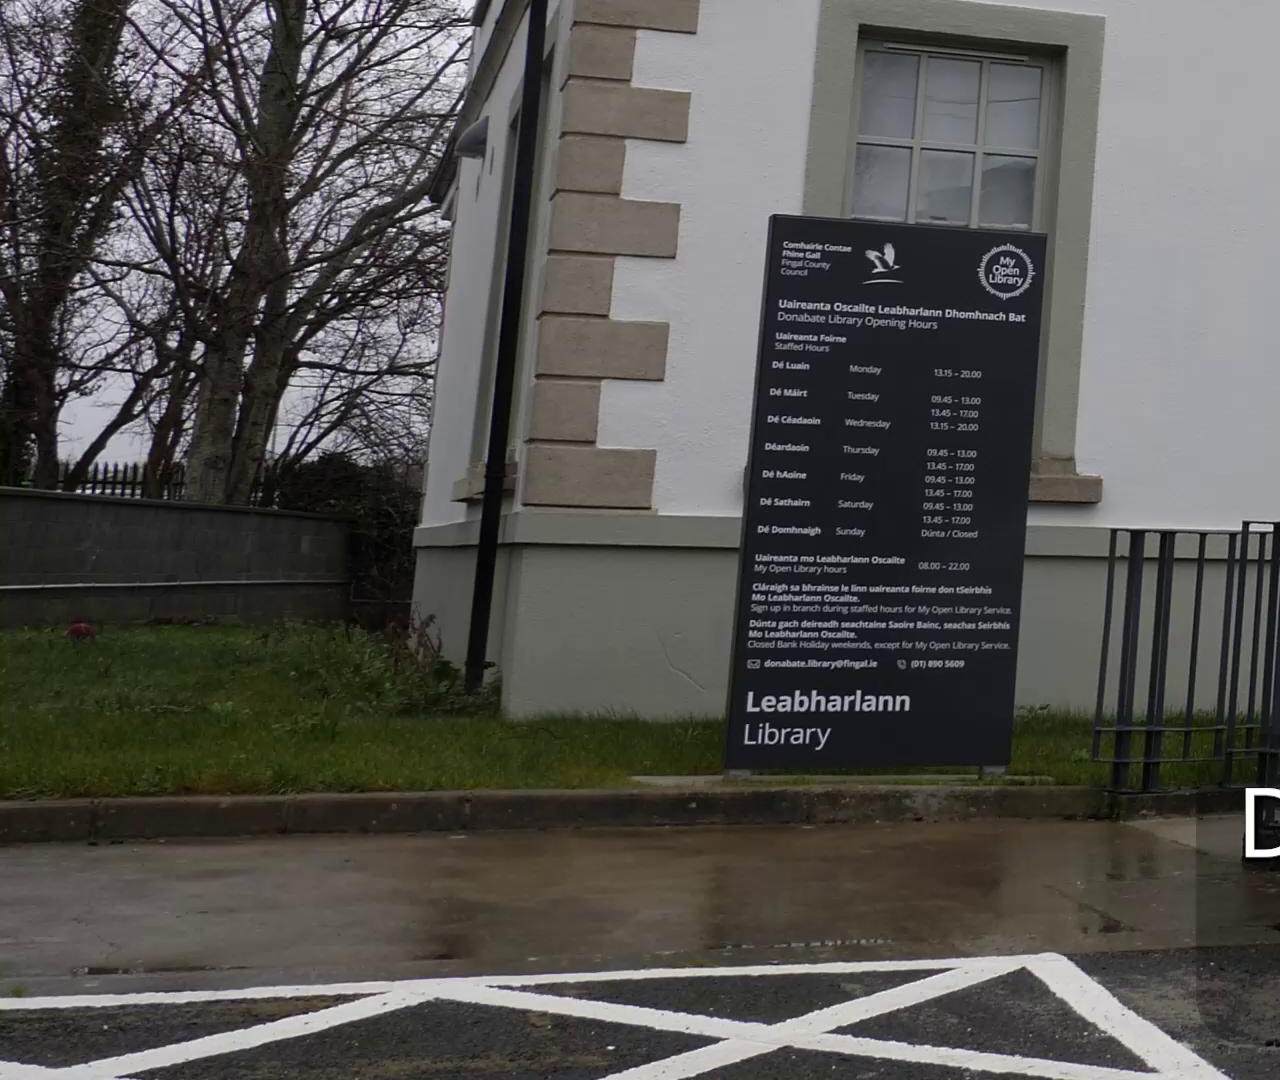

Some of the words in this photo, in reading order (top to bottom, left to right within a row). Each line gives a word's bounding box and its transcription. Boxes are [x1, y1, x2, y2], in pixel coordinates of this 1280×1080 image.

[783, 241, 823, 251] Comhairle
[824, 244, 852, 253] Contae
[782, 250, 804, 259] Fhine
[805, 251, 821, 260] Gall
[781, 259, 803, 269] Fingal
[804, 260, 831, 271] County
[999, 256, 1016, 268] My
[780, 268, 808, 276] Council
[992, 265, 1020, 276] Open
[989, 274, 1024, 287] Library
[778, 299, 831, 311] Uaireanta
[833, 302, 876, 313] Oscailte
[878, 305, 942, 318] Leabharlann
[945, 308, 1006, 322] Dhomhnach
[1008, 313, 1027, 323] Bat
[777, 311, 826, 324] Donabate
[828, 314, 864, 327] Library
[864, 316, 907, 330] Opening
[908, 320, 938, 330] Hours
[776, 332, 818, 342] Uaireanta
[819, 334, 848, 344] Foirne
[774, 342, 804, 352] Staffed
[804, 343, 830, 353] Hours
[772, 360, 784, 369] Dé
[785, 361, 810, 370] Luain
[849, 365, 882, 376] Monday
[934, 368, 953, 377] 13.15
[960, 369, 982, 379] 20.00
[769, 388, 782, 396] Dé
[783, 388, 808, 397] Máirt
[847, 391, 880, 402] Tuesday
[930, 395, 953, 404] 09.45
[961, 396, 981, 405] 13.00
[931, 408, 952, 417] 13.45
[960, 409, 979, 418] 17.00
[767, 415, 780, 424] Dé
[781, 416, 821, 425] Céadaoin
[844, 419, 891, 430] Wednesday
[930, 422, 949, 431] 13.15
[957, 423, 979, 432] 20.00
[764, 442, 810, 452] Déardaoin
[842, 445, 880, 456] Thursday
[926, 448, 949, 457] 09.45
[957, 449, 977, 458] 13.00
[927, 462, 947, 471] 13.45
[955, 463, 975, 472] 17.00
[762, 469, 775, 478] Dé
[775, 470, 807, 480] hAoine
[840, 472, 865, 483] Friday
[924, 475, 947, 484] 09.45
[954, 476, 976, 485] 13.00
[924, 489, 945, 497] 13.45
[953, 490, 973, 498] 17.00
[760, 497, 773, 506] Dé
[773, 498, 811, 507] Sathairn
[838, 500, 874, 511] Saturday
[922, 502, 945, 511] 09.45
[953, 503, 974, 512] 13.00
[922, 515, 943, 524] 13.45
[951, 516, 971, 525] 17.00
[757, 525, 770, 534] Dé
[771, 525, 822, 537] Domhnaigh
[835, 527, 866, 538] Sunday
[921, 529, 946, 538] Dúnta
[952, 530, 979, 539] Closed
[755, 554, 798, 562] Uaireanta
[816, 555, 870, 563] Leabharlann
[871, 556, 906, 565] Oscailte
[754, 564, 767, 574] My
[768, 564, 792, 573] Open
[793, 565, 823, 575] Library
[823, 565, 847, 574] hours
[918, 562, 941, 570] 08.00
[948, 563, 970, 571] 22.00
[752, 583, 788, 593] Cláraigh
[801, 583, 840, 592] bhrainse
[868, 584, 910, 593] uaireanta
[911, 585, 937, 593] foirne
[938, 585, 955, 593] don
[751, 593, 767, 601] Mo
[767, 594, 822, 602] Leabharlann
[750, 603, 769, 614] Sign
[792, 604, 821, 613] branch
[822, 605, 849, 615] during
[850, 605, 879, 613] staffed
[879, 605, 903, 613] hours
[917, 605, 931, 615] My
[931, 606, 954, 615] Open
[955, 606, 983, 616] Library
[749, 620, 777, 628] Dúnta
[777, 621, 800, 630] gach
[800, 620, 840, 629] deireadh
[840, 621, 887, 629] seachtaine
[888, 621, 915, 629] Saoire
[943, 622, 977, 630] seachas
[748, 630, 764, 638] Mo
[764, 630, 819, 639] Leabharlann
[747, 640, 776, 649] Closed
[776, 640, 798, 648] Bank
[799, 641, 831, 651] Holiday
[874, 642, 901, 651] except
[901, 641, 914, 649] for
[915, 642, 928, 651] My
[928, 642, 952, 651] Open
[952, 642, 980, 652] Library
[763, 659, 878, 670] donabate.library@fingal.ie
[911, 660, 927, 670] (01)
[746, 690, 912, 713] Leabharlann
[743, 722, 832, 751] Library
